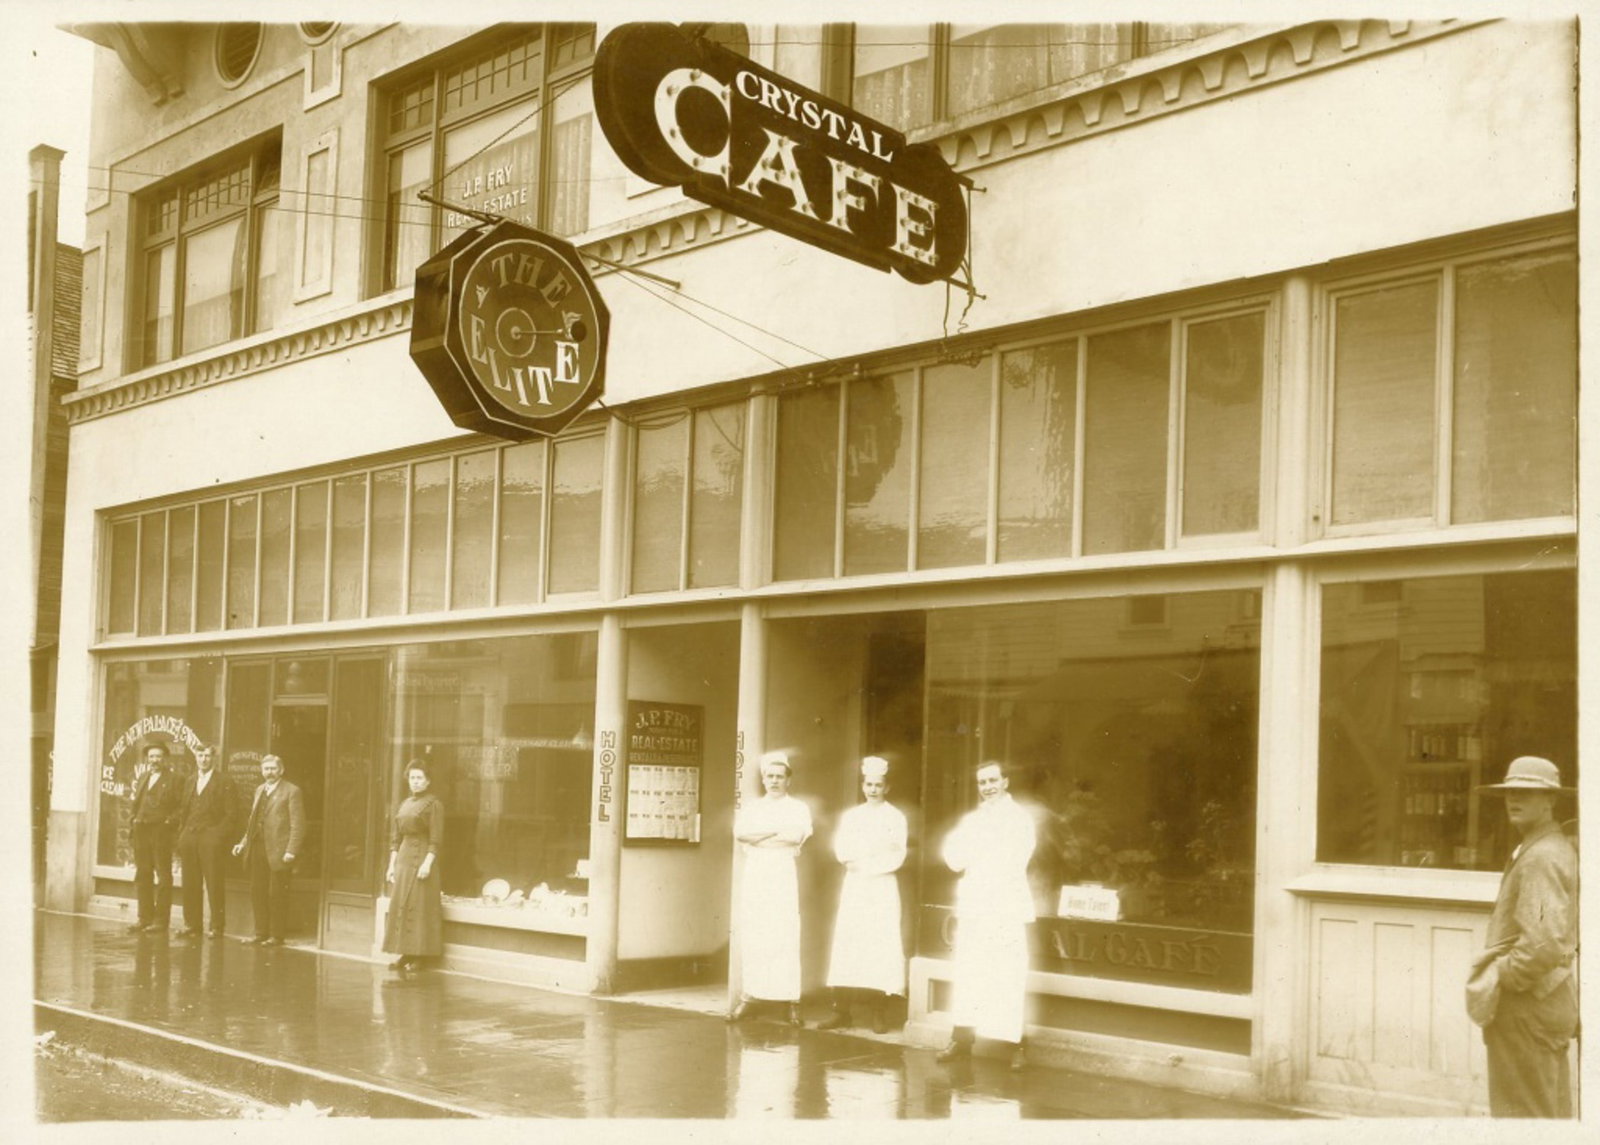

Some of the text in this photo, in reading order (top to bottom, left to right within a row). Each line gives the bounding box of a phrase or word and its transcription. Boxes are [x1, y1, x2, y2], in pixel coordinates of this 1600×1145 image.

[736, 71, 894, 162] CRYSTAL
[486, 165, 513, 192] FRY
[655, 68, 937, 266] CAFE
[483, 187, 528, 215] ESTATE
[491, 252, 573, 308] THE
[470, 314, 580, 407] ELITE
[631, 735, 698, 753] REAL ESTATE
[663, 710, 697, 731] FRY
[598, 731, 616, 822] HOTEL
